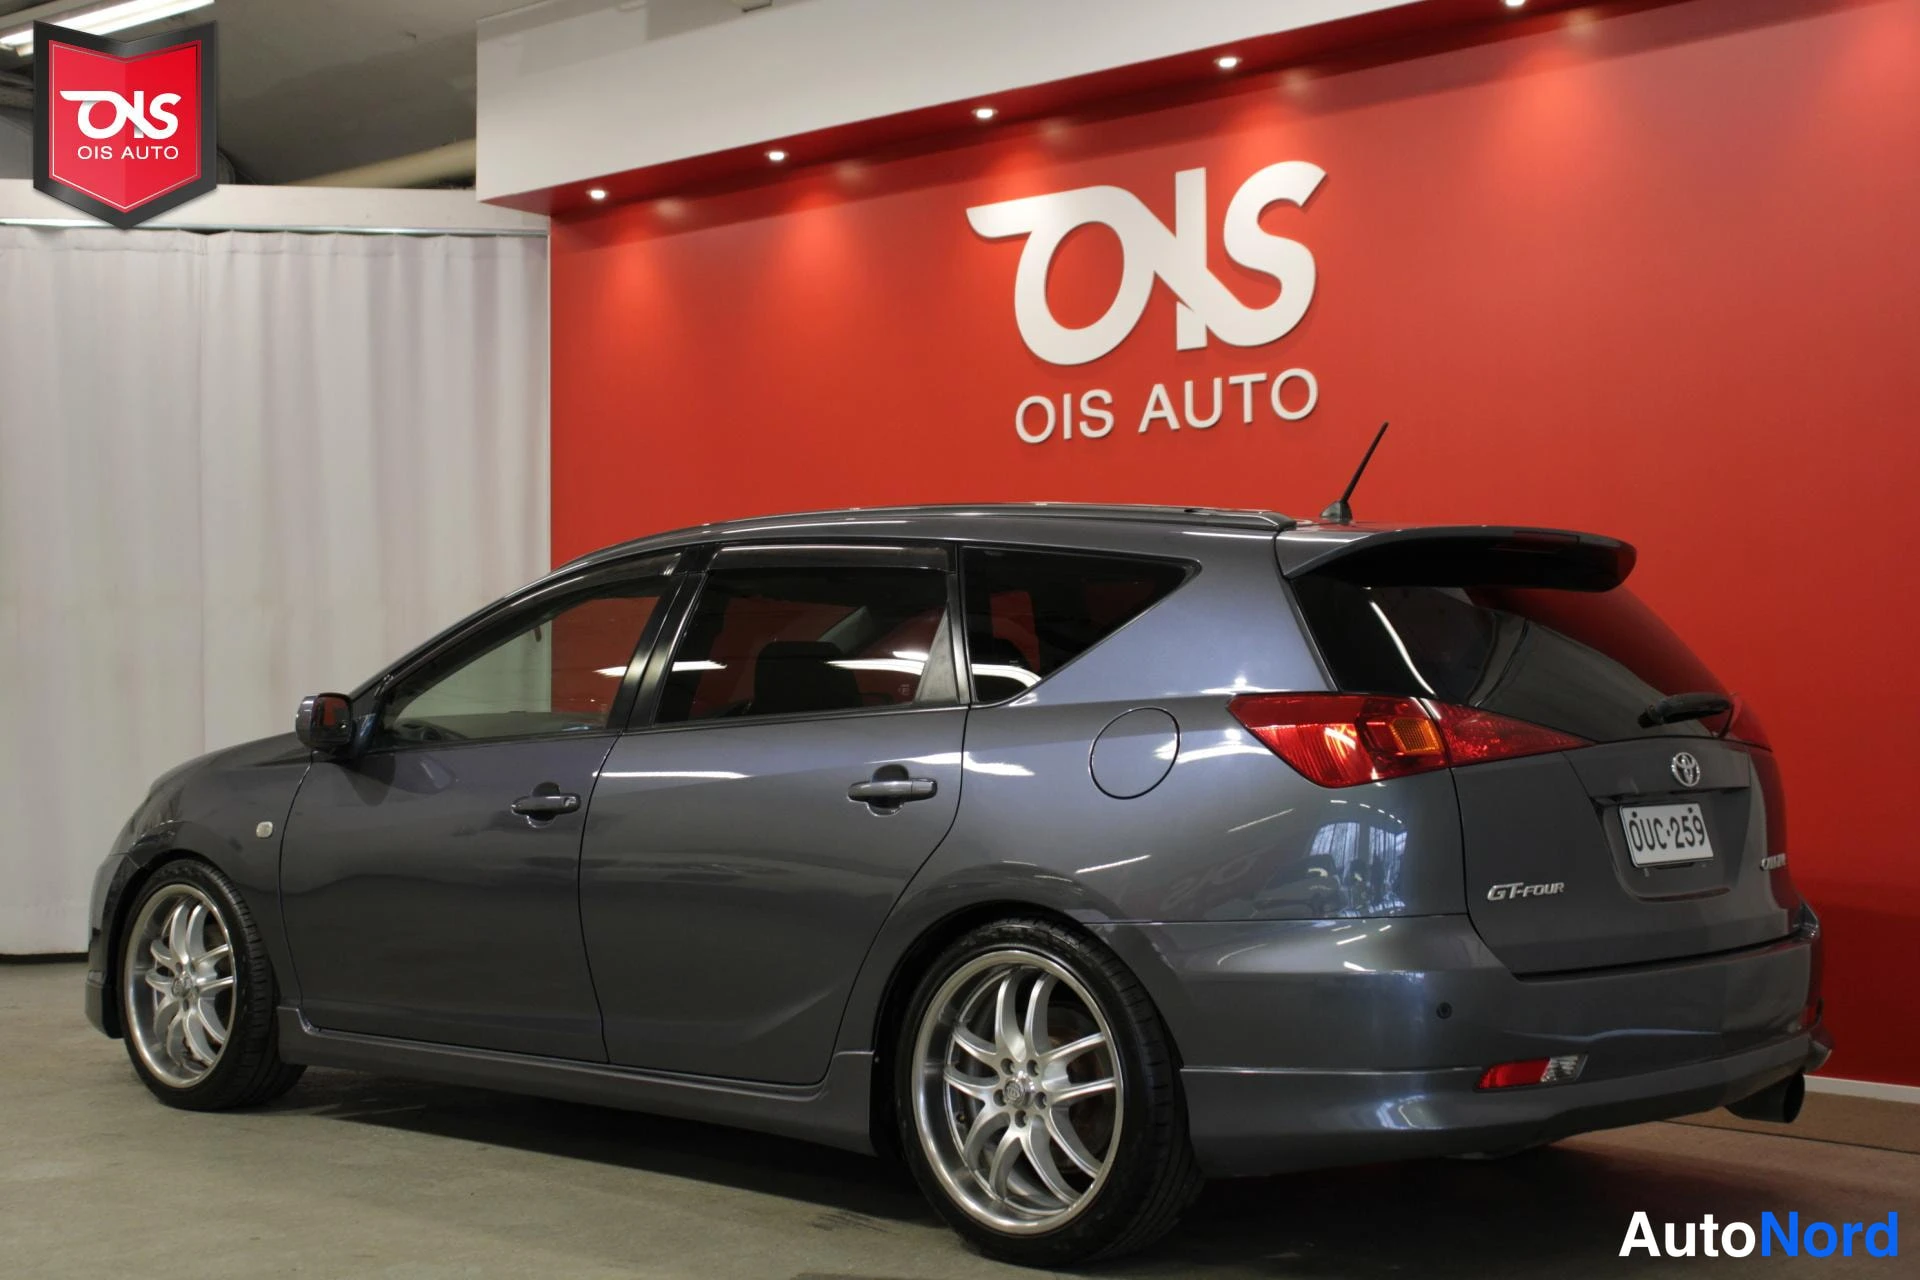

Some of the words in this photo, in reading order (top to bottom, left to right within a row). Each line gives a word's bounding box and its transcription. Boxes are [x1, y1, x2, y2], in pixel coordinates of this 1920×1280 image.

[1015, 389, 1114, 443] OIS
[1138, 368, 1318, 432] AUTO
[1629, 814, 1705, 851] OUC-259
[1487, 882, 1564, 901] GT-FOUR
